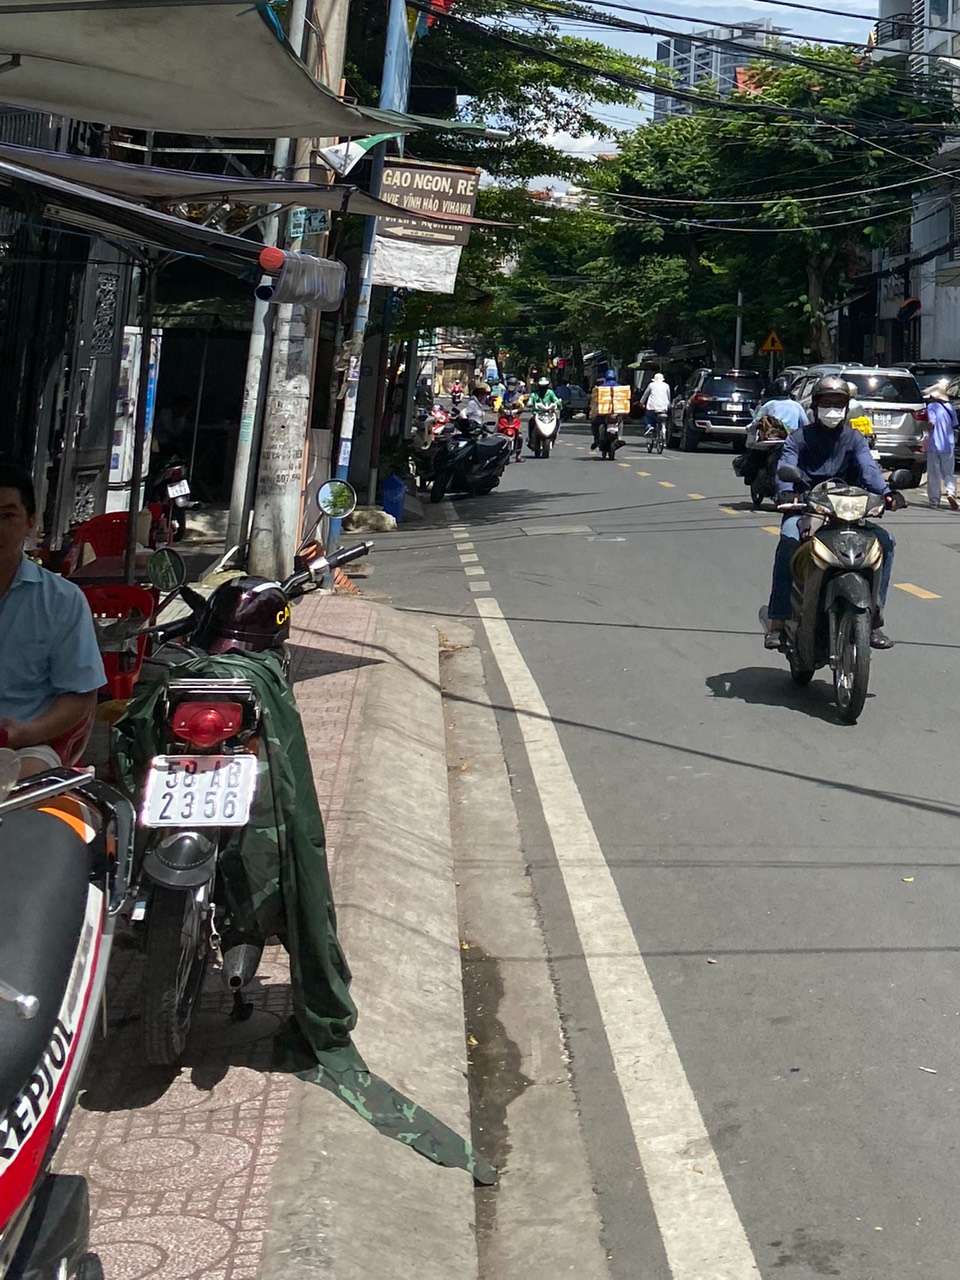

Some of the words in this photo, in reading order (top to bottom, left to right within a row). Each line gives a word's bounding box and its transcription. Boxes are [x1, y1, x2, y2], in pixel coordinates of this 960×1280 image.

[383, 170, 411, 189] GẠO
[413, 173, 453, 196] NGON,
[456, 175, 476, 195] RẺ
[158, 790, 238, 820] 2356
